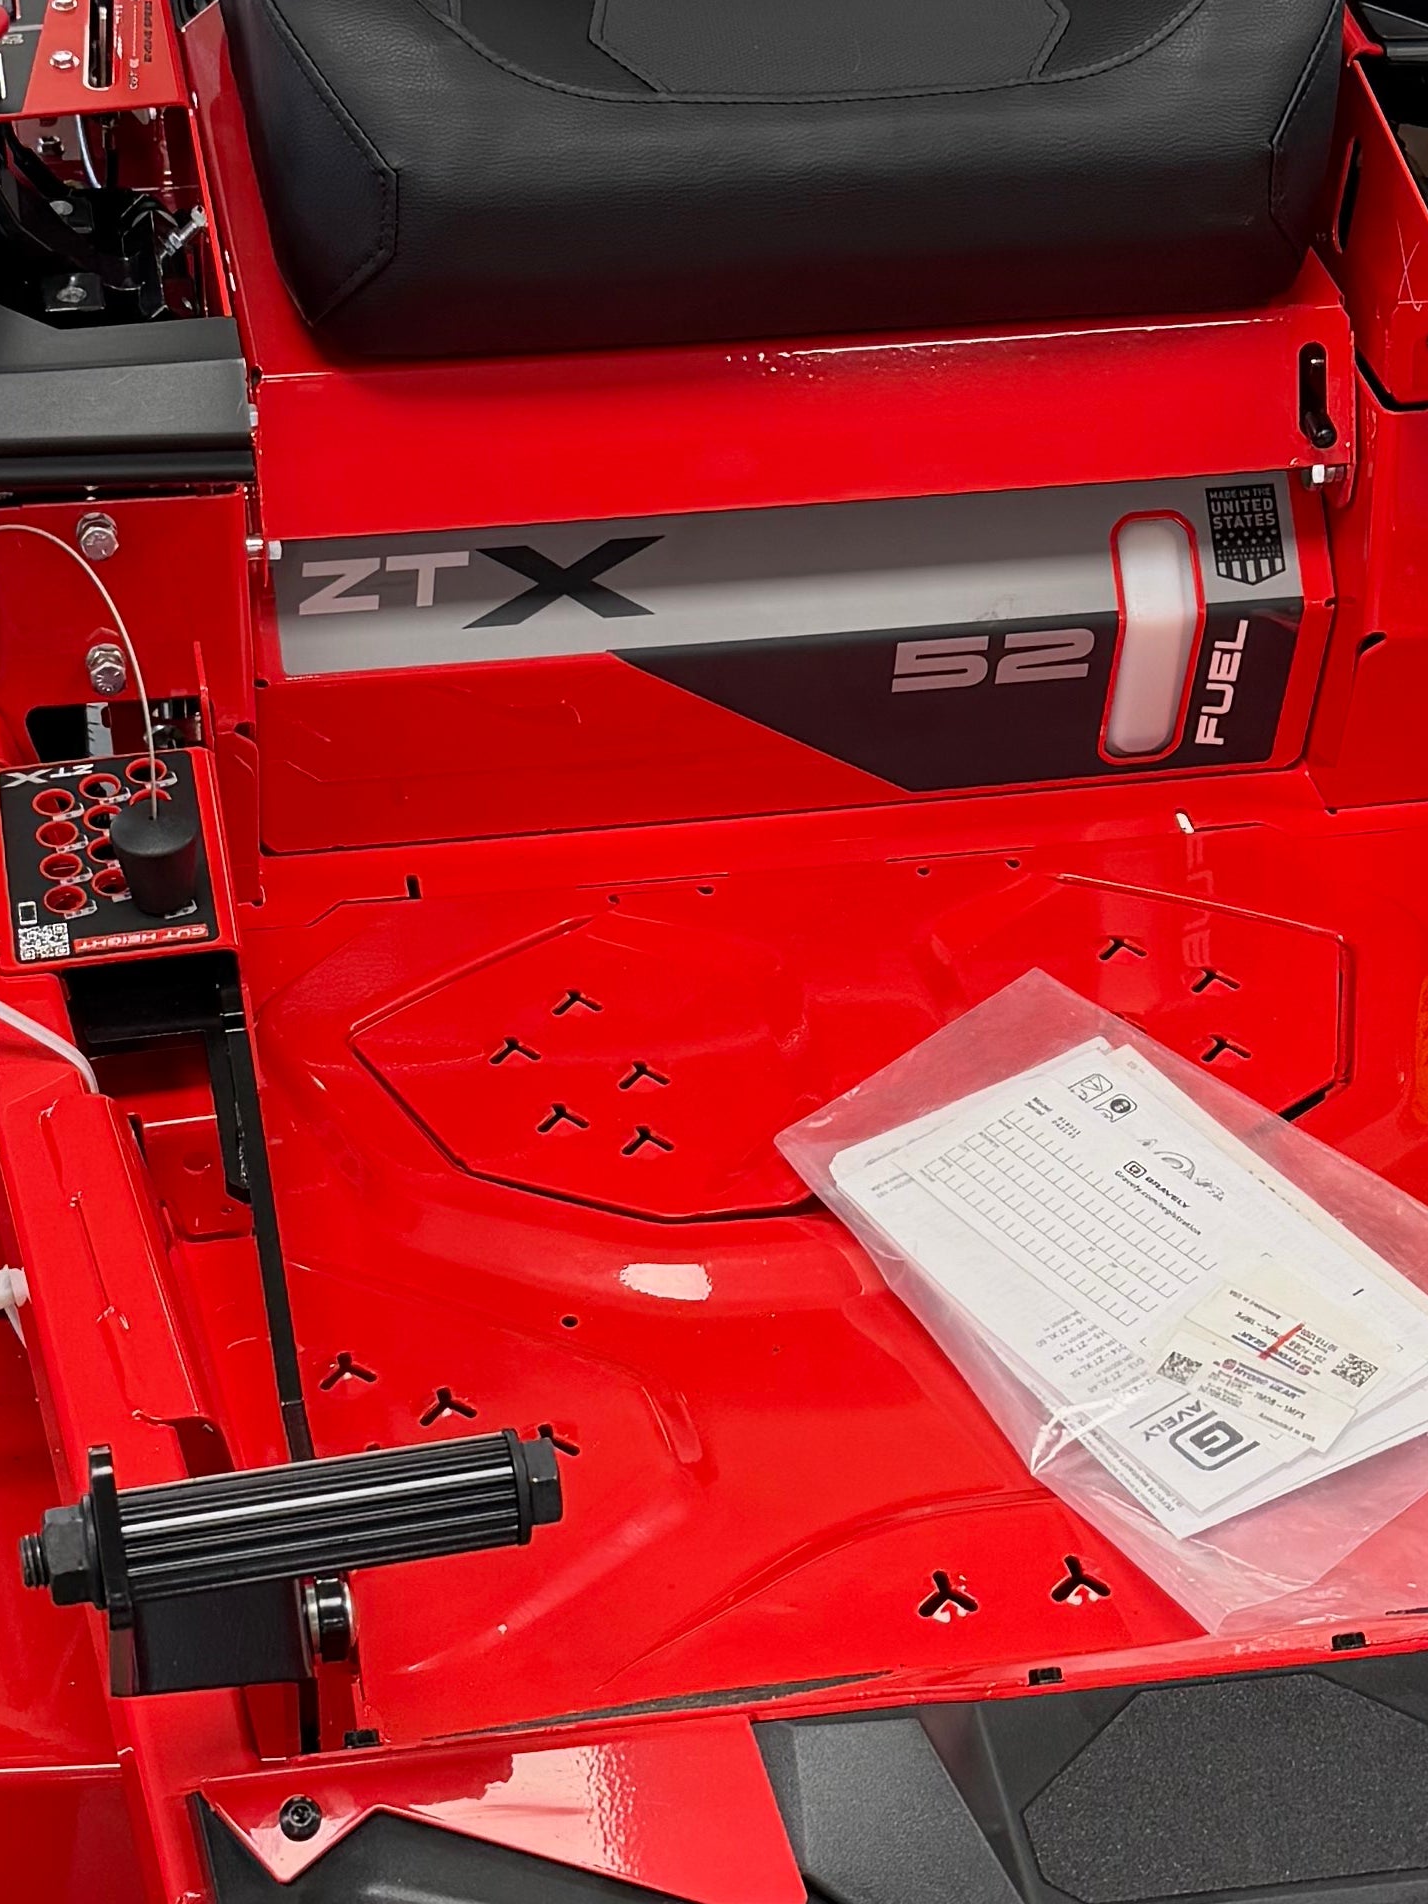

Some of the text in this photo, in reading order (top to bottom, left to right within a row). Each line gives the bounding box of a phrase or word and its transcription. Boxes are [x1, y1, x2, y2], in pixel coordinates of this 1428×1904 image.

[1211, 498, 1273, 514] UNITED
[1213, 513, 1275, 529] STATES
[892, 628, 1095, 693] 52
[1195, 619, 1248, 745] FUEL
[80, 925, 207, 949] CUT HEIGHT
[1146, 1177, 1190, 1208] GRAVELY
[1141, 1399, 1204, 1442] AVELY
